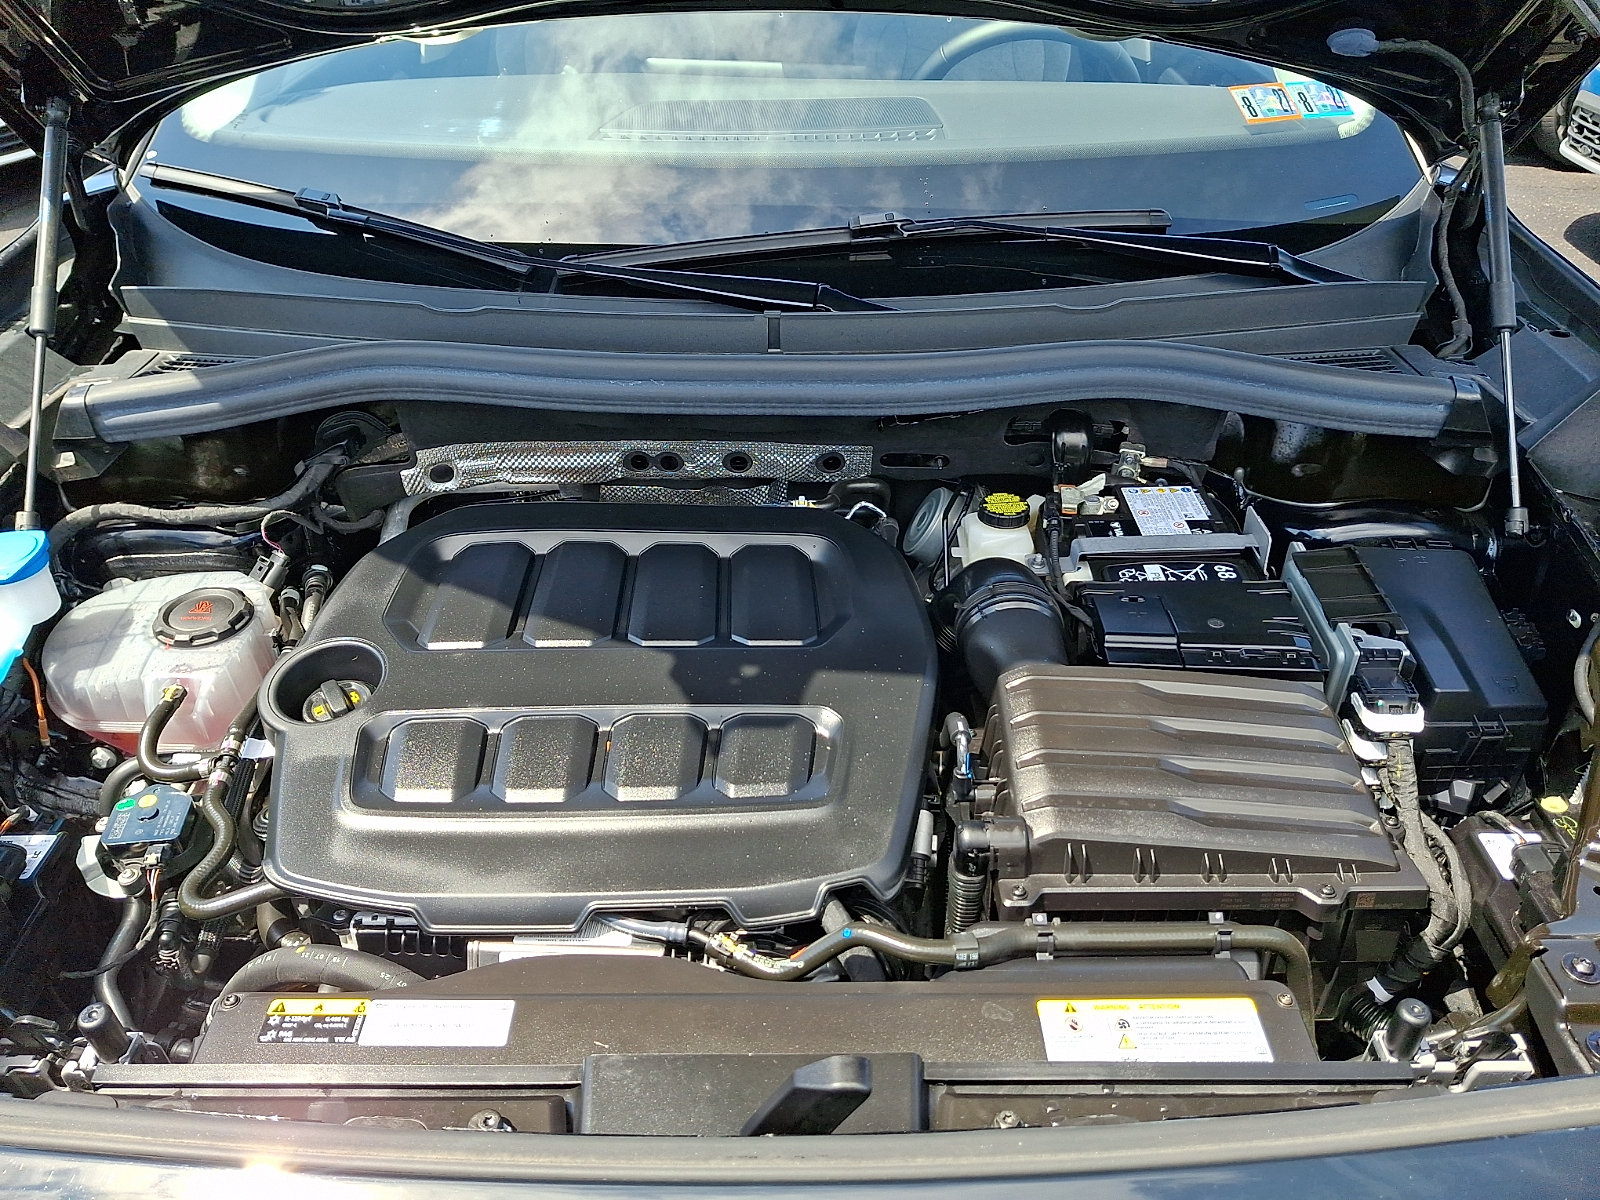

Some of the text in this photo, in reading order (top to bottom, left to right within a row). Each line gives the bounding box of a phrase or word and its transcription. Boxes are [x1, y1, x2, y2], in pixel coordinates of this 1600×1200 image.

[1242, 88, 1294, 117] 8 27
[1298, 91, 1314, 112] 8
